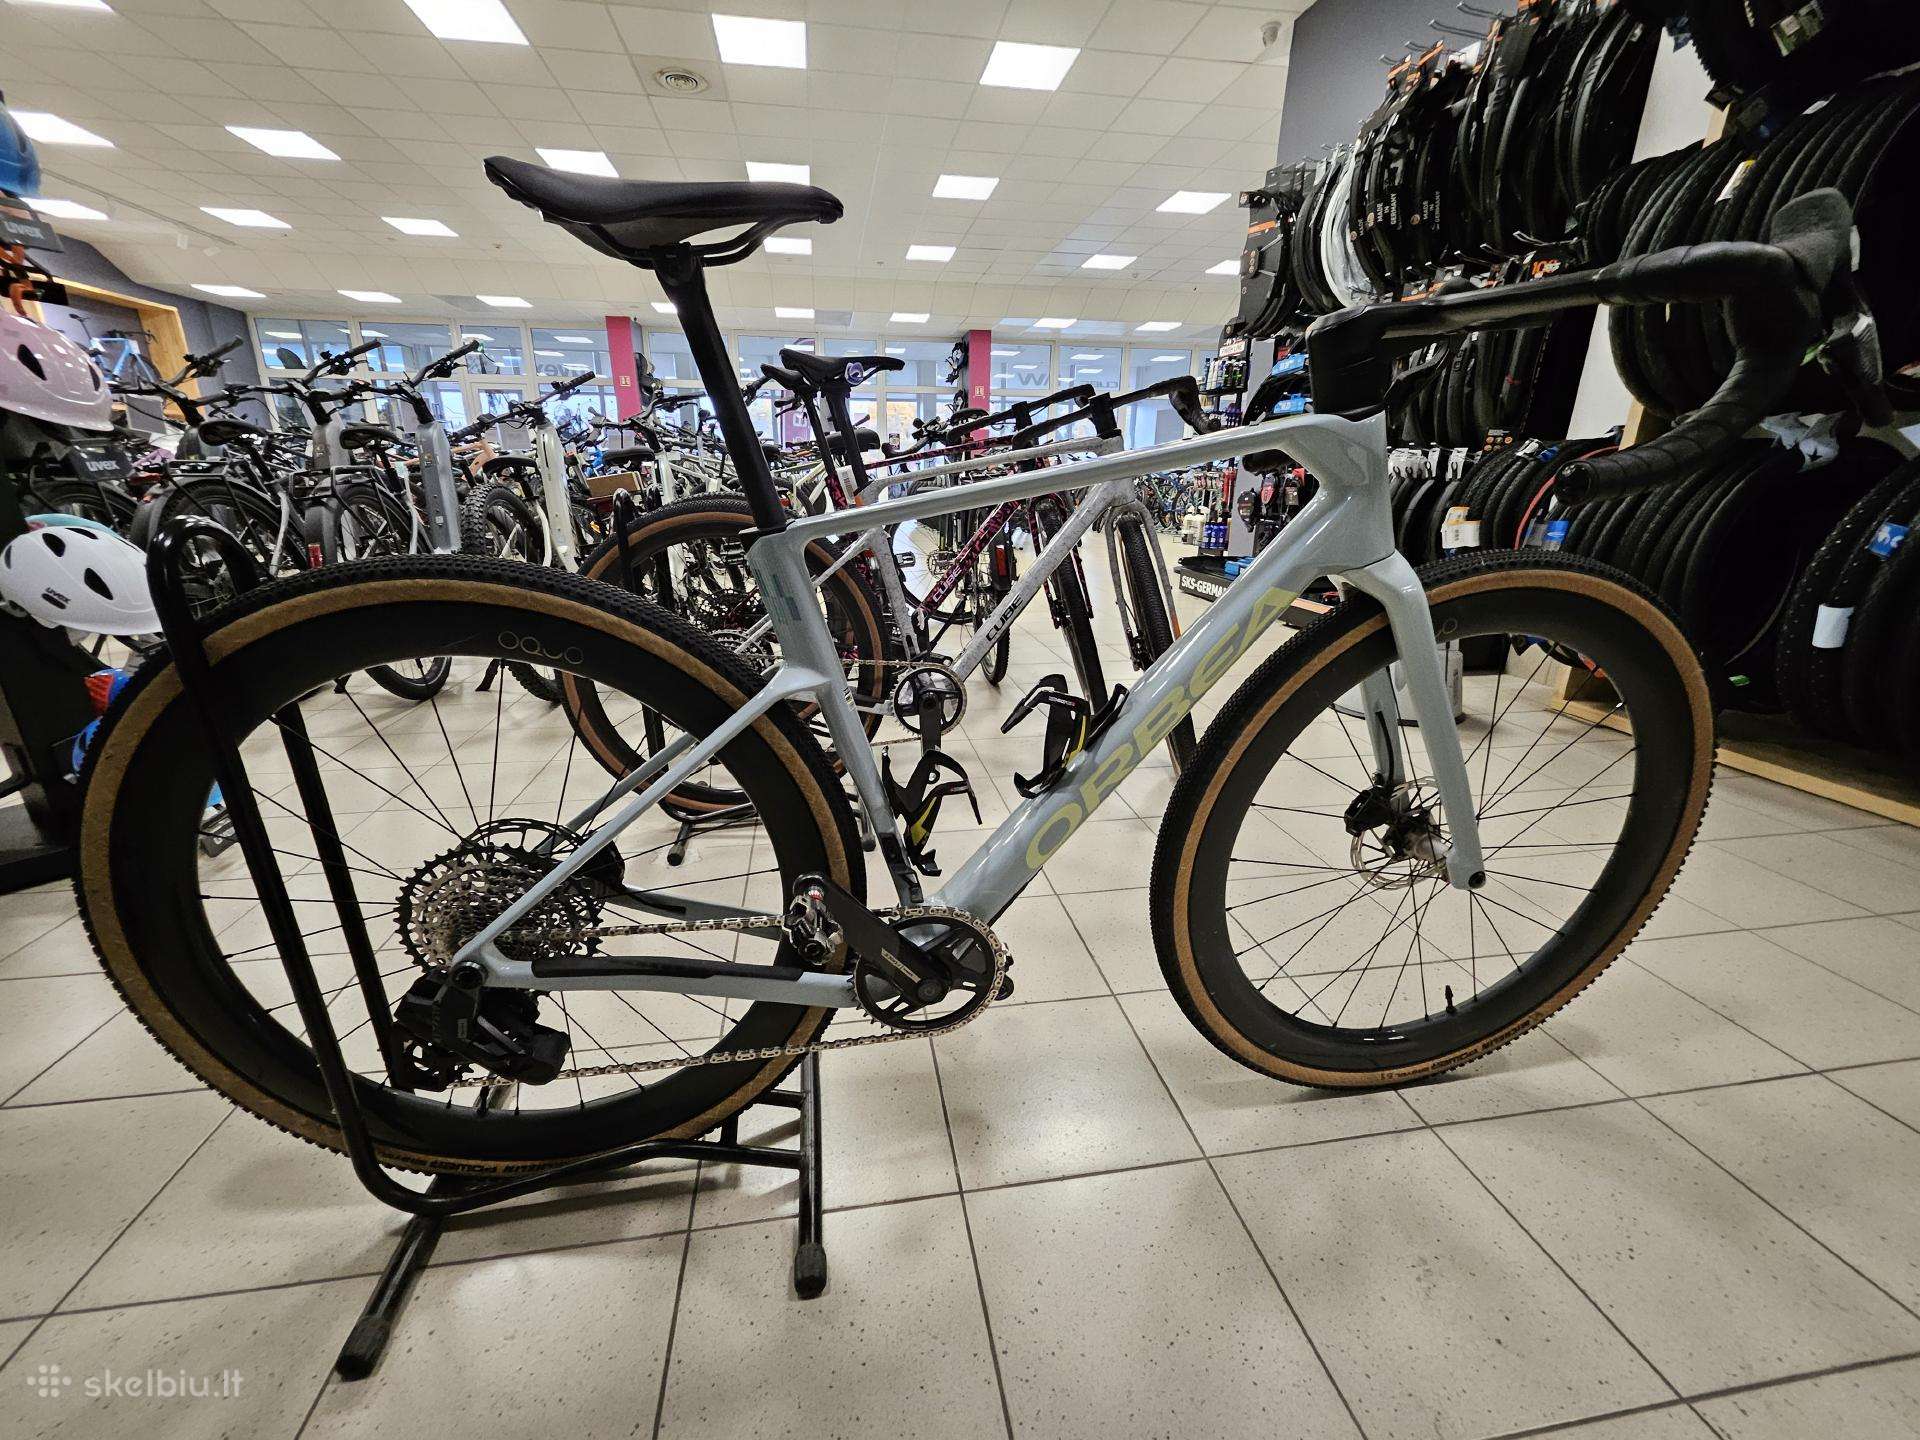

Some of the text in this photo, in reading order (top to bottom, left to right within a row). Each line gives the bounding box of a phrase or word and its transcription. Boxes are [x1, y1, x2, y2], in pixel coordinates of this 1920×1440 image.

[85, 460, 120, 472] uvex
[932, 565, 963, 602] CUBE
[986, 594, 1023, 641] CUBE
[1026, 586, 1300, 869] ORBEA
